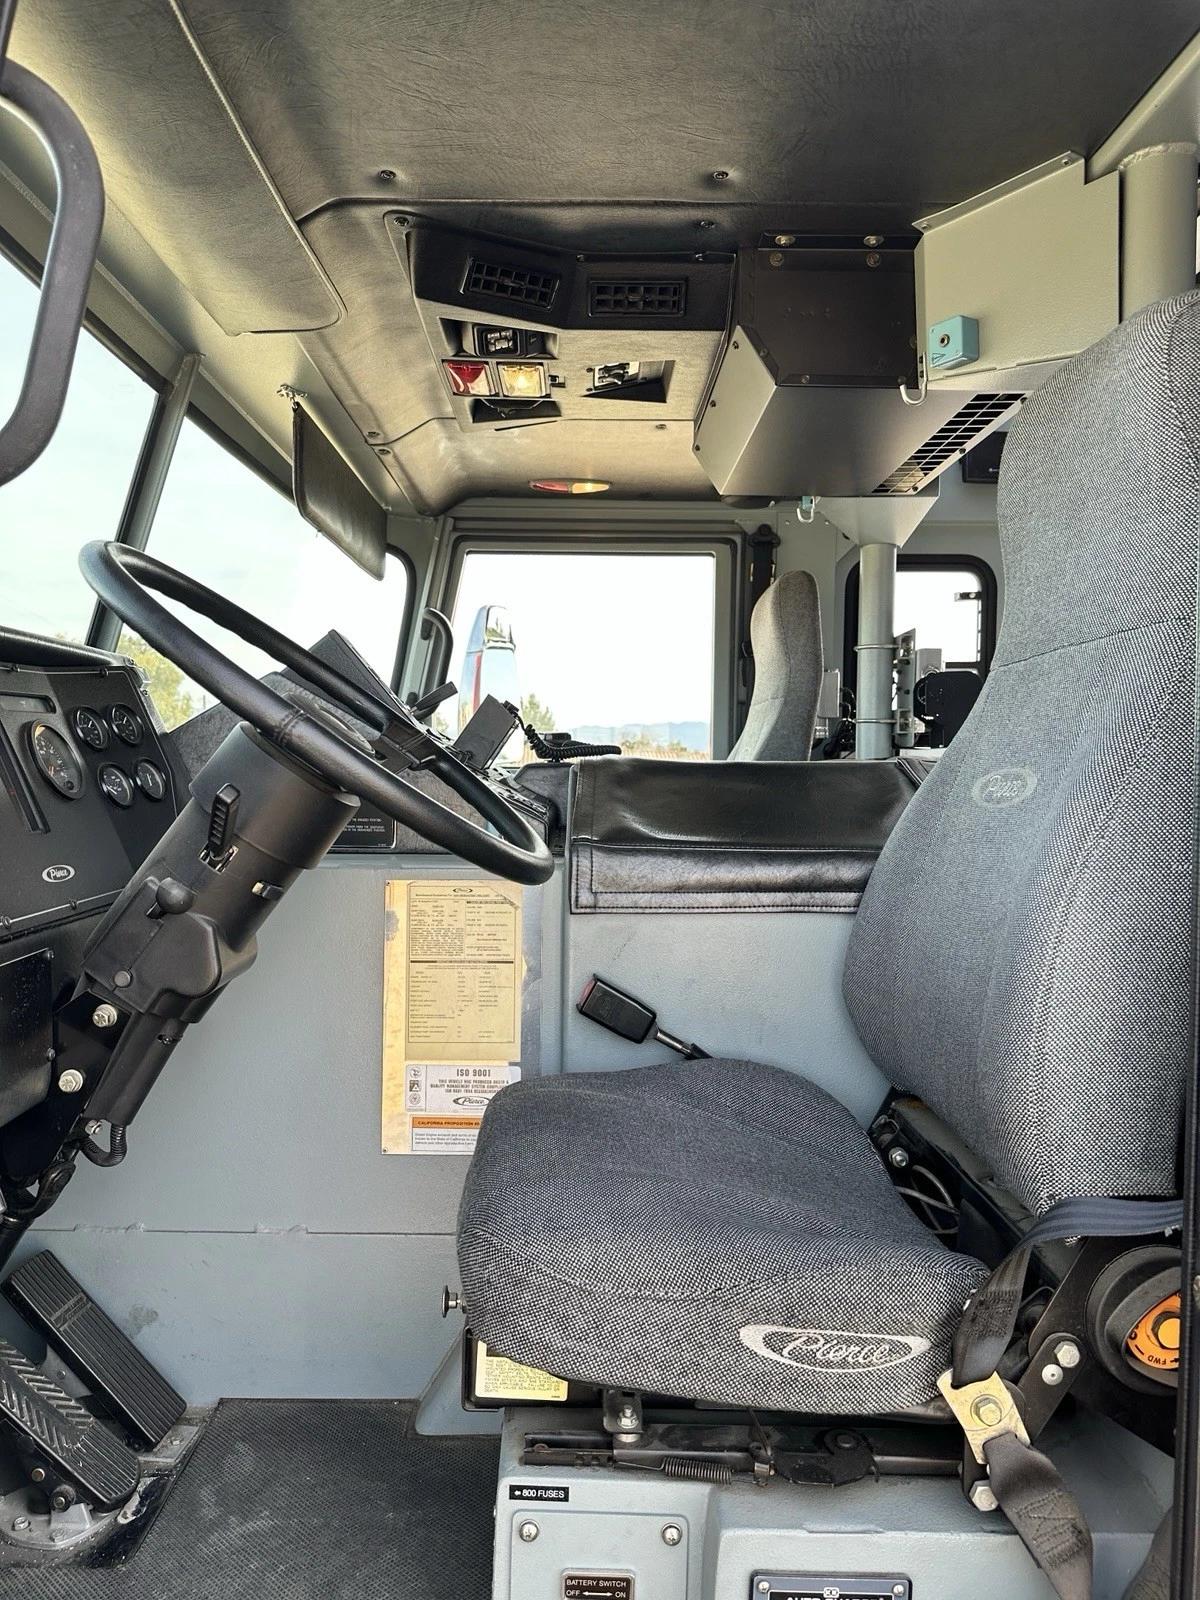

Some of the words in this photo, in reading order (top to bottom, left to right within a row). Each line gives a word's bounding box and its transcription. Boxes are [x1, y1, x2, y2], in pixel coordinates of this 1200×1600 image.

[456, 1068, 470, 1077] ISO
[472, 1068, 491, 1078] 9001
[781, 1333, 890, 1363] Pierce
[1147, 1355, 1167, 1365] FWD
[522, 1489, 537, 1497] 800
[537, 1489, 565, 1498] FUSES
[566, 1579, 598, 1587] BATTERY
[598, 1580, 627, 1588] SWITCH
[565, 1589, 580, 1597] OFF
